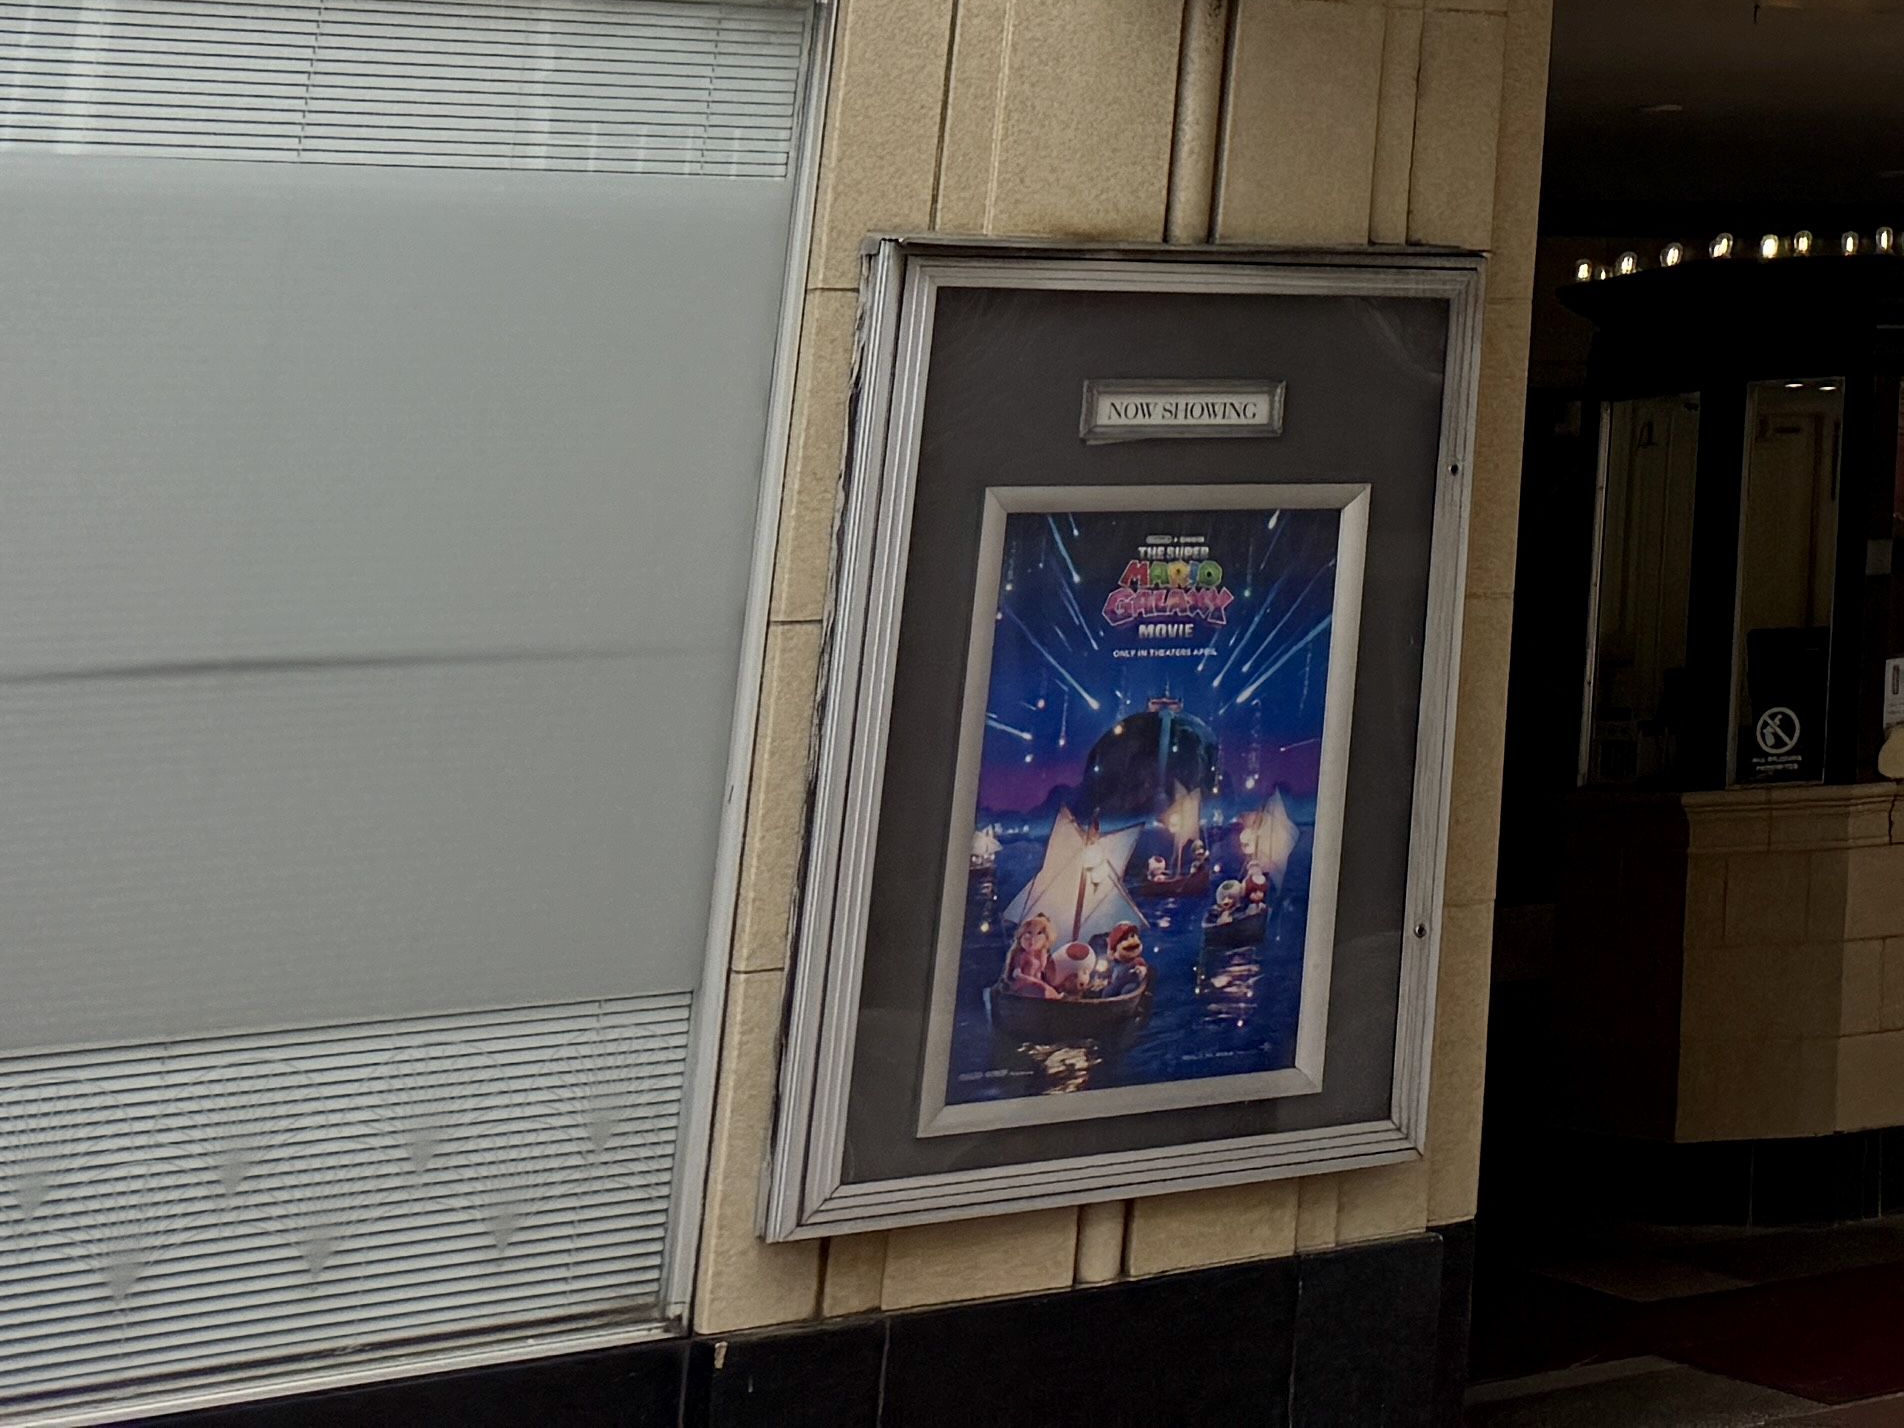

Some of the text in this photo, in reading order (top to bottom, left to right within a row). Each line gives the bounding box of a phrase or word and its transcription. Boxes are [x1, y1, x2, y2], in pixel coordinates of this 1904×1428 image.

[1108, 401, 1257, 420] NOW SHOWING
[1138, 546, 1209, 559] THE SUPER
[1118, 559, 1223, 588] MARIO
[1102, 587, 1235, 627] GALAXY
[1138, 623, 1195, 639] MOVIE
